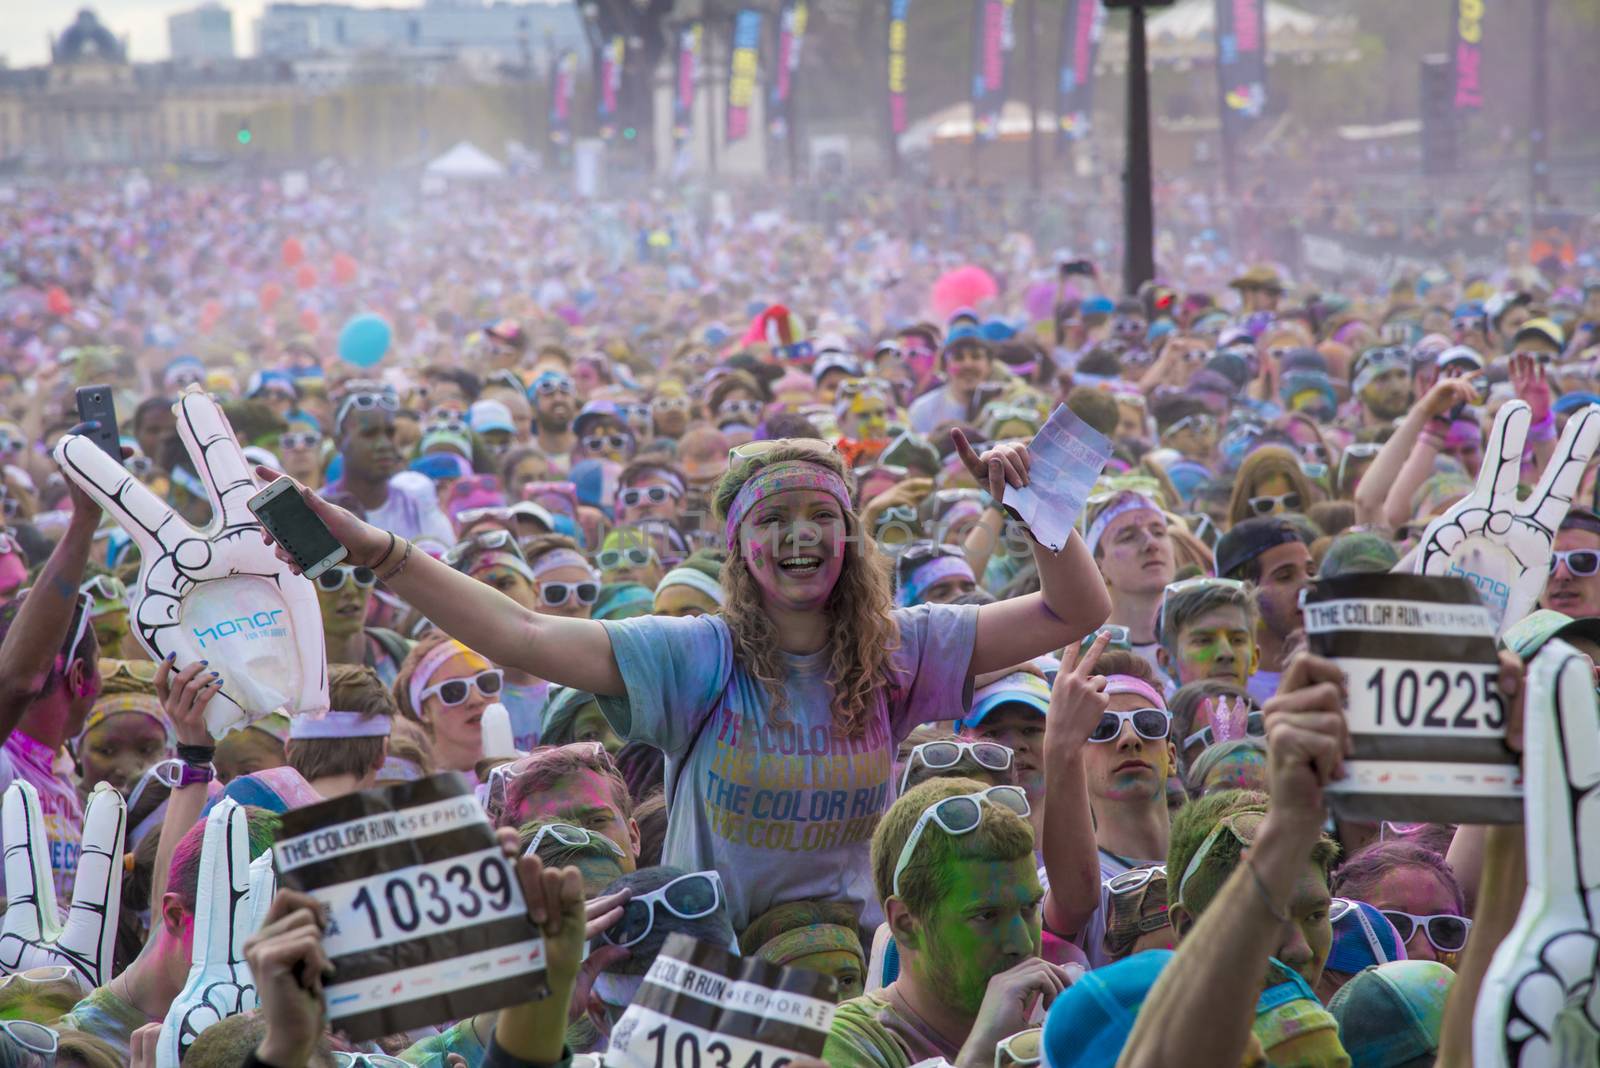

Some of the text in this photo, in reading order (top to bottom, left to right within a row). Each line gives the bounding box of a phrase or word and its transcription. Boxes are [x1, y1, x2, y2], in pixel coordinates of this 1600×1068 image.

[1311, 605, 1340, 629] THE
[1343, 604, 1392, 626] COLOR
[1366, 667, 1505, 730] 10225
[706, 769, 751, 816] THE
[751, 789, 849, 823] COLOR
[281, 842, 313, 865] THE
[314, 823, 369, 855] COLOR
[368, 815, 399, 842] RUN
[746, 820, 841, 853] COLOR
[351, 855, 513, 940] 10339
[694, 974, 727, 1000] RUN
